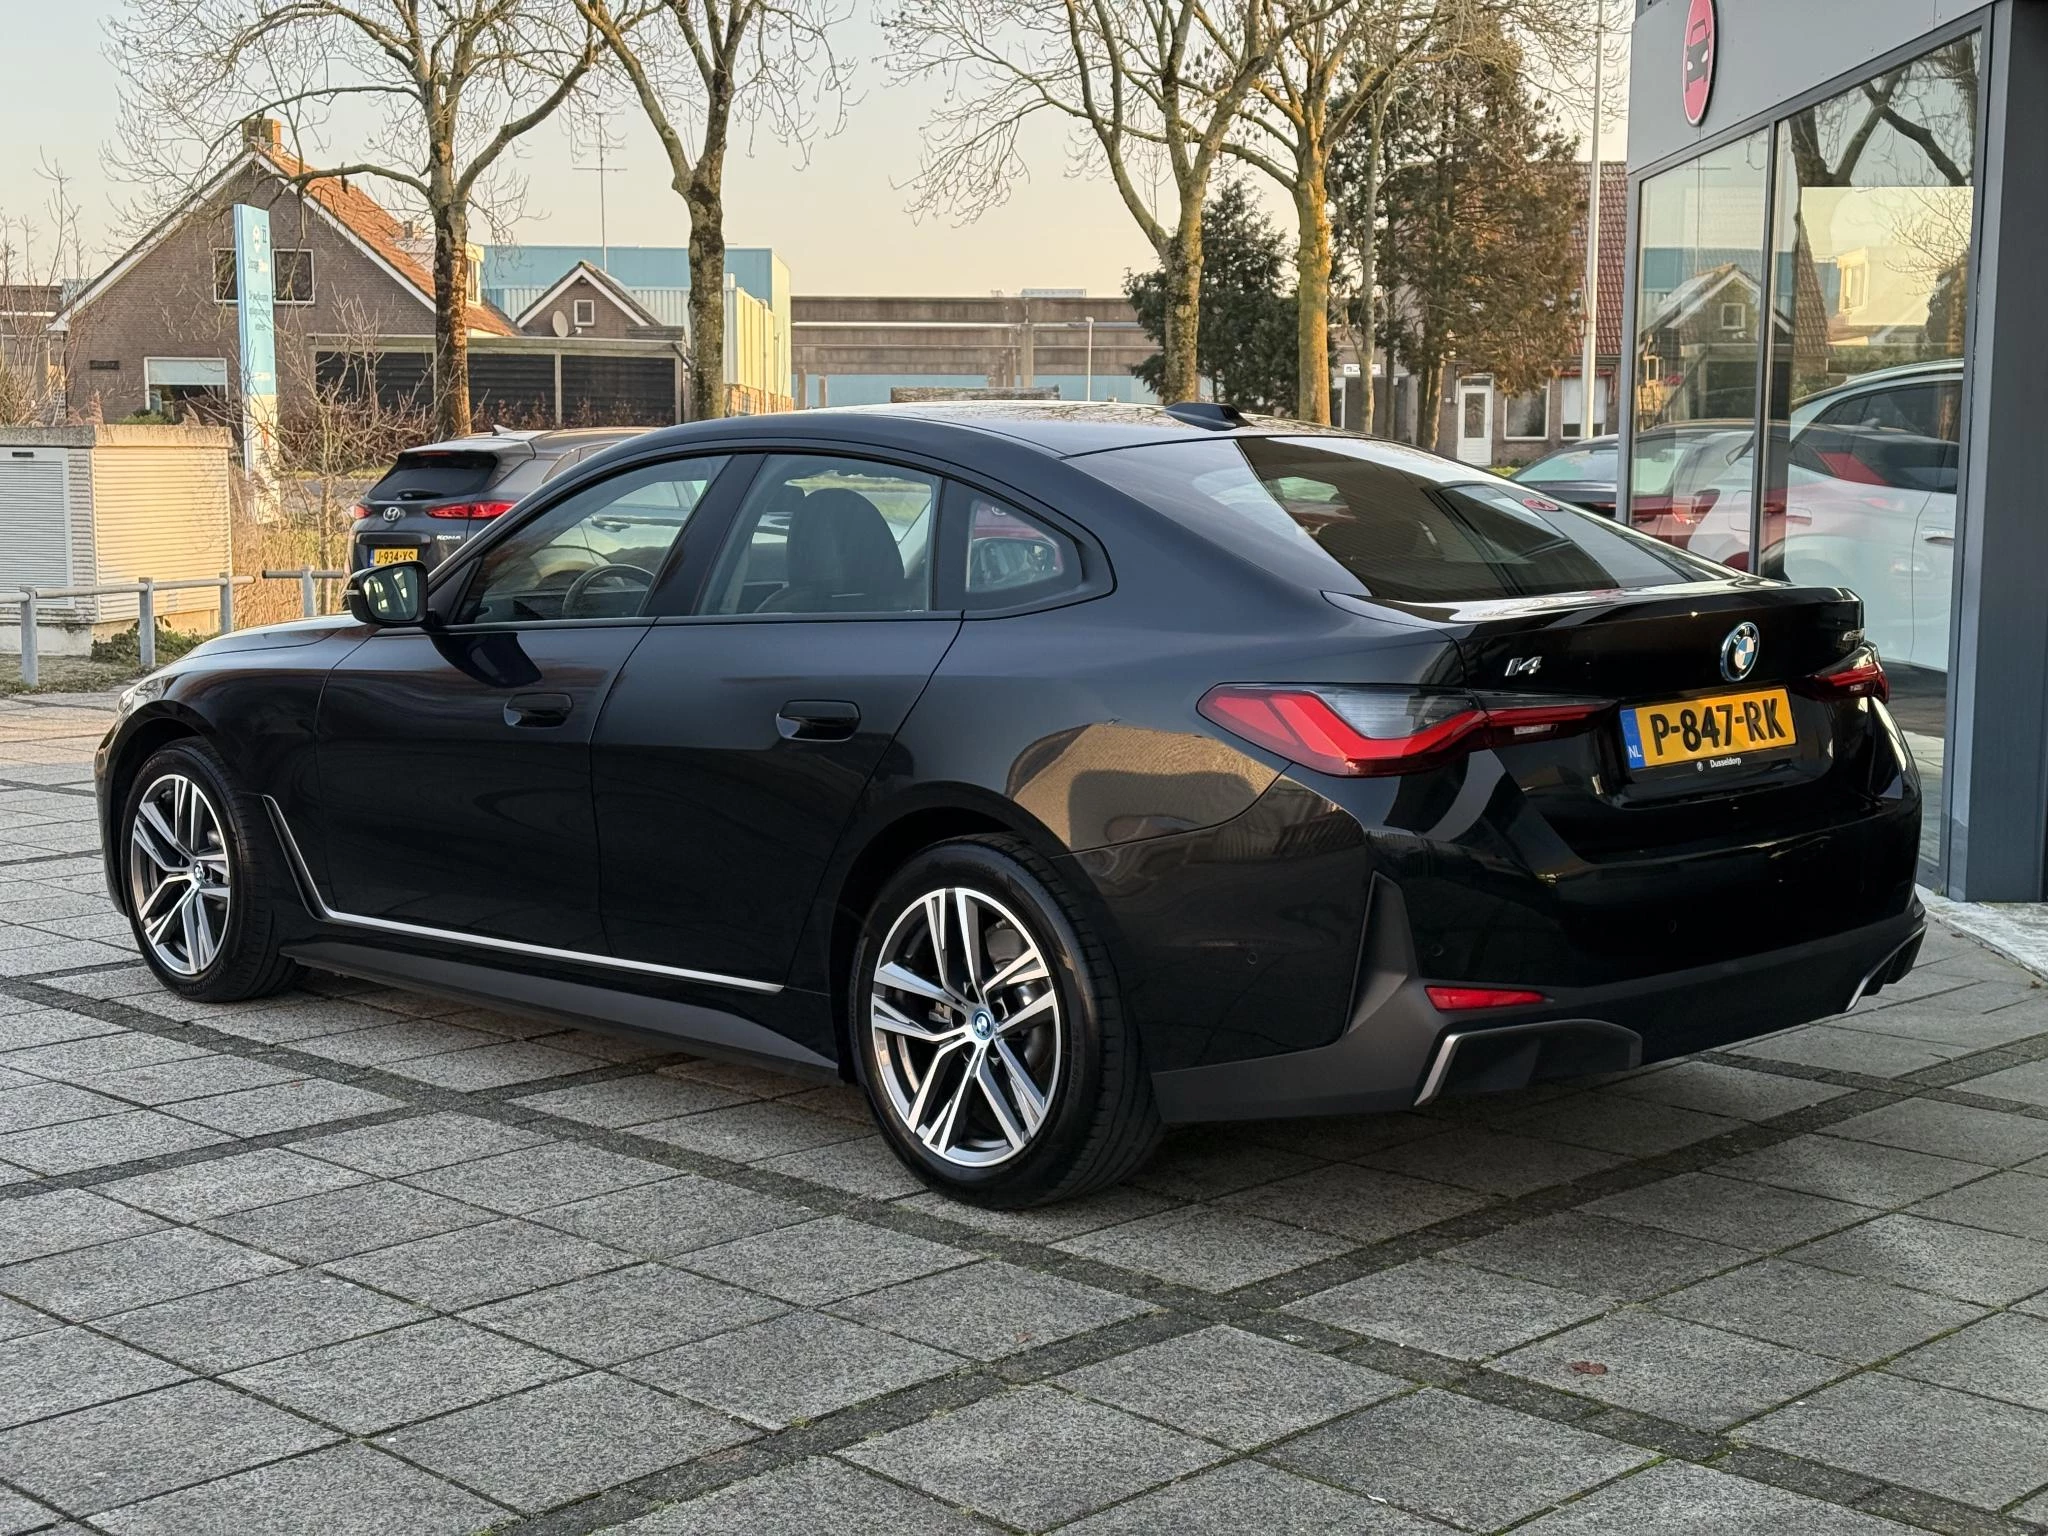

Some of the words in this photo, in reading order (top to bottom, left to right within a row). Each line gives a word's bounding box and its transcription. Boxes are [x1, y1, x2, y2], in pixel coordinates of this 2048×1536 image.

[1650, 698, 1786, 756] P-847-RK
[1628, 745, 1642, 759] NL
[1710, 756, 1742, 769] Dusseldorp
